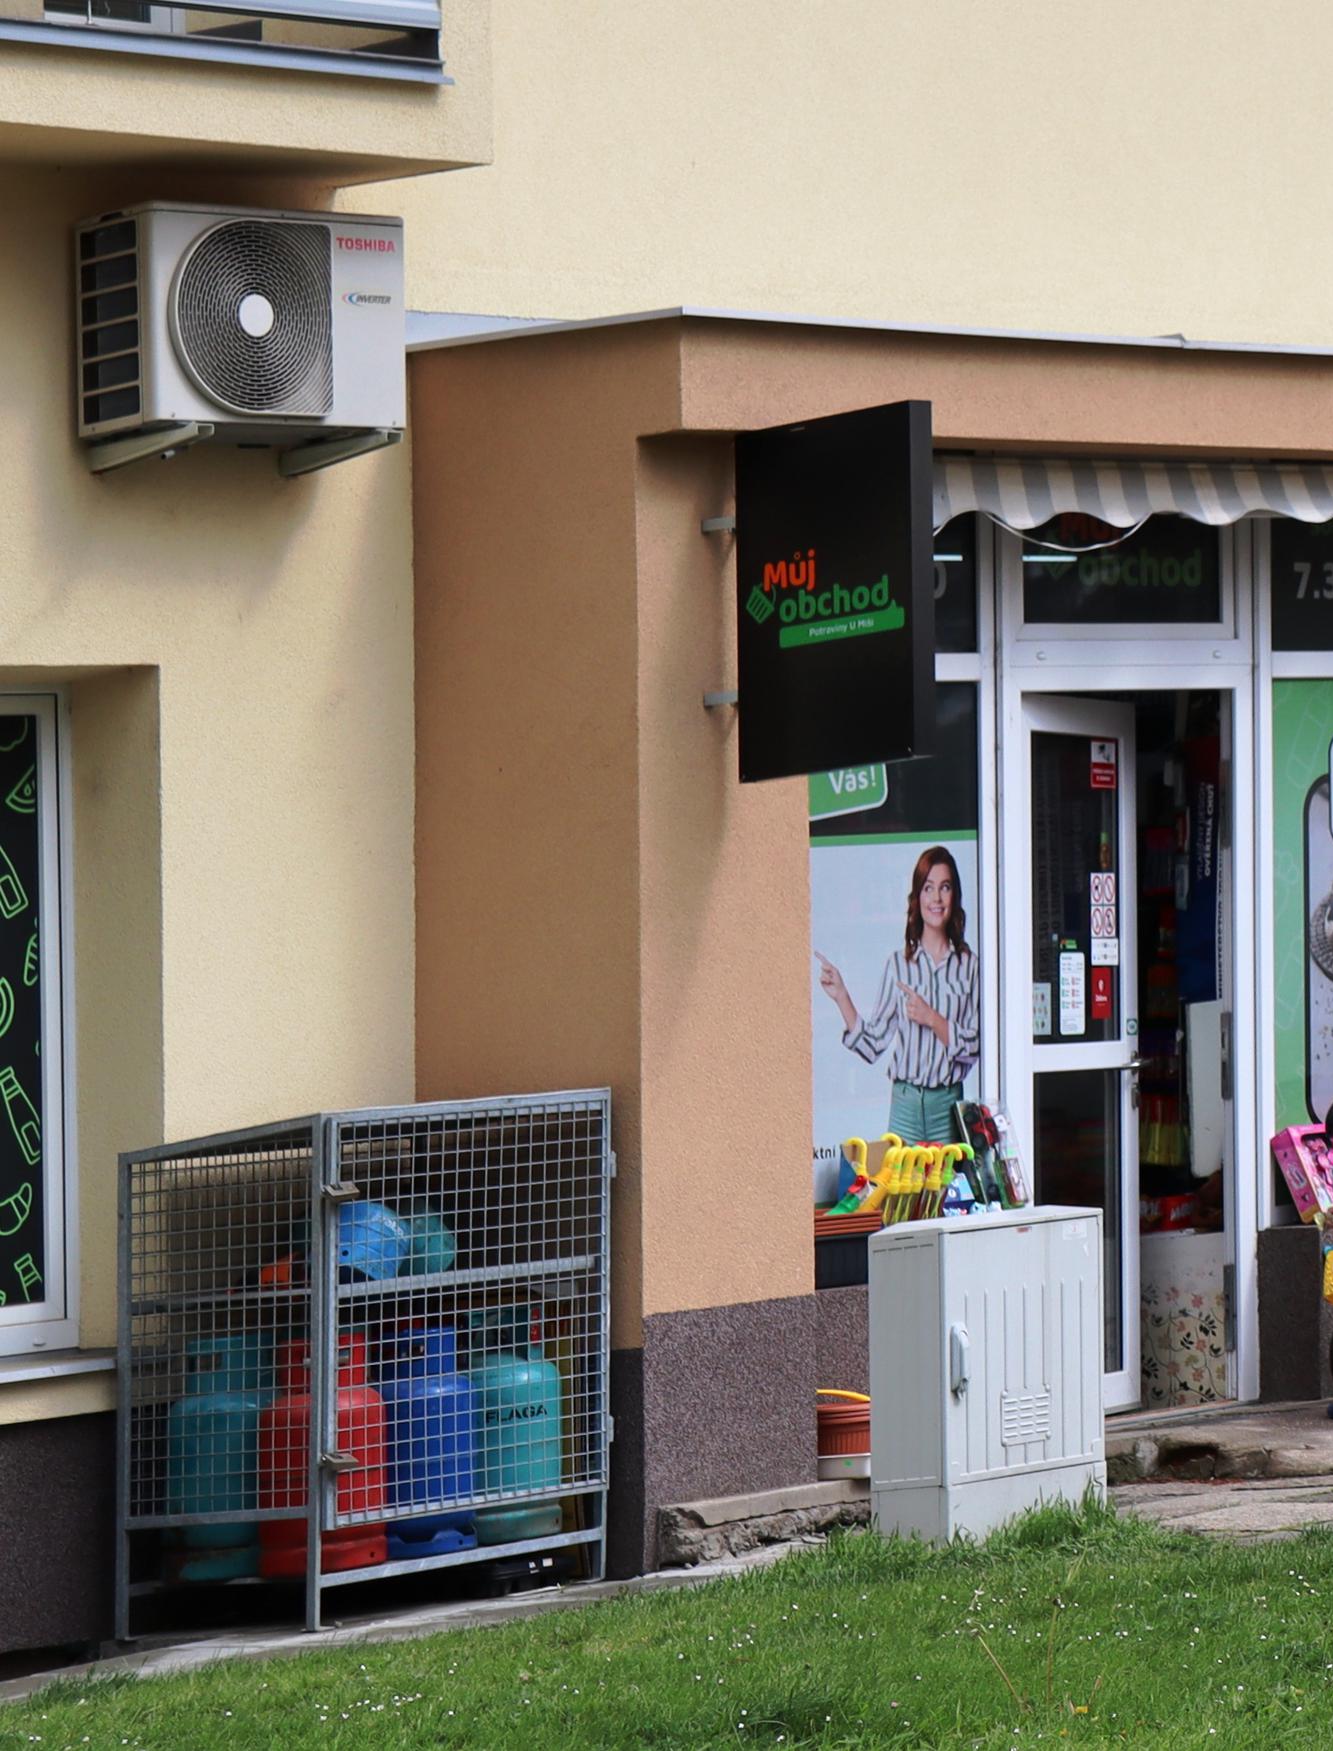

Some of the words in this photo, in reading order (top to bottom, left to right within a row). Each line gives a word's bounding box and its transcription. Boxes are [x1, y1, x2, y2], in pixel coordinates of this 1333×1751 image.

[336, 236, 396, 253] TOSHIBA
[763, 549, 816, 592] Můj
[1078, 547, 1203, 588] obchod
[779, 574, 889, 623] obchod
[808, 621, 848, 638] Potraviny
[849, 618, 856, 631] U
[828, 765, 876, 794] Vás!
[486, 1404, 548, 1424] FLAGA
